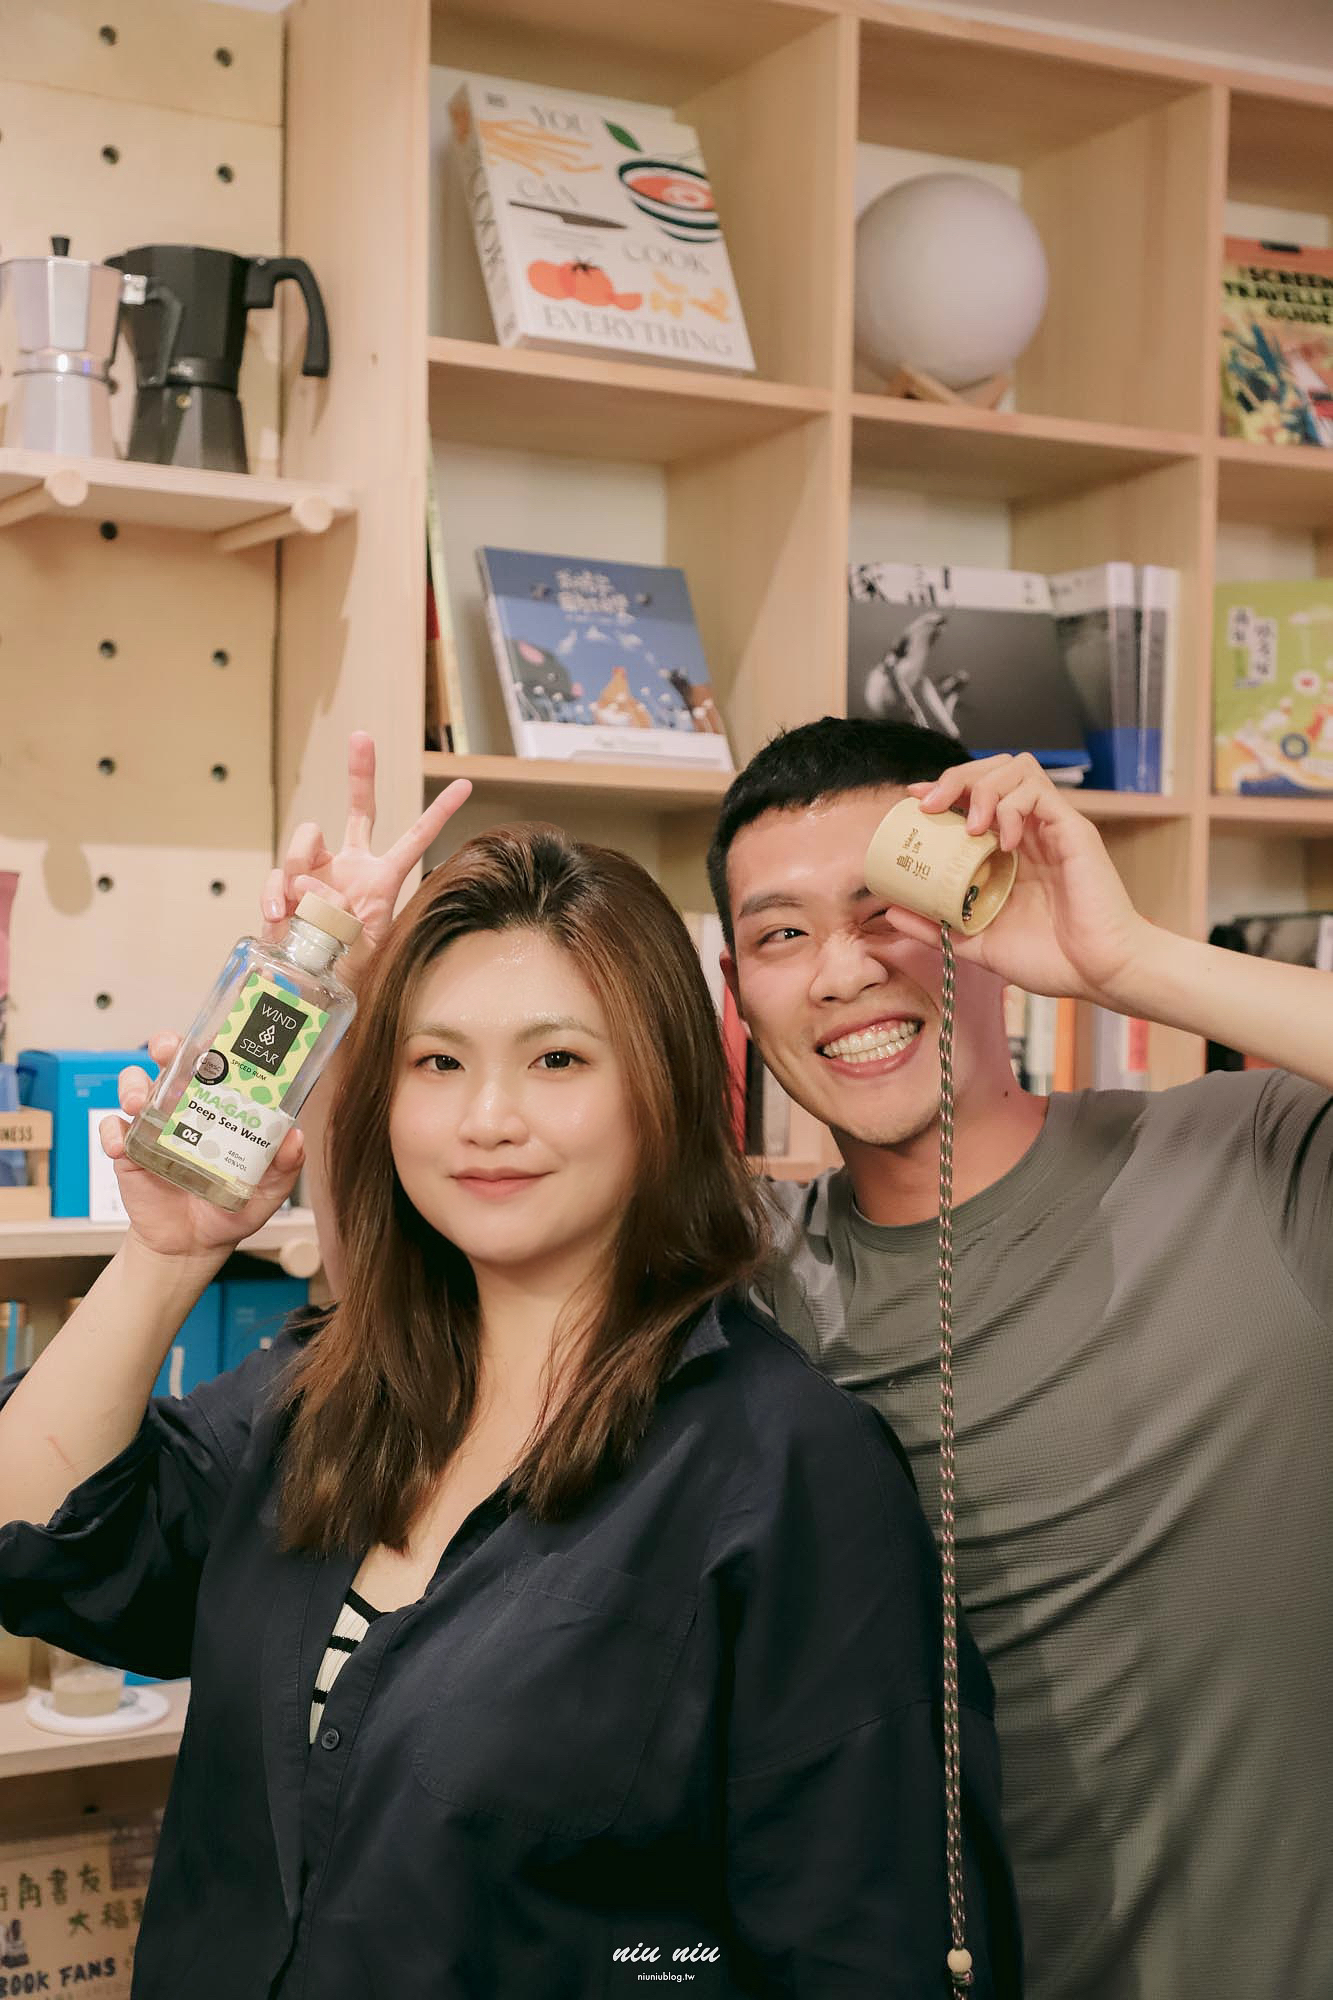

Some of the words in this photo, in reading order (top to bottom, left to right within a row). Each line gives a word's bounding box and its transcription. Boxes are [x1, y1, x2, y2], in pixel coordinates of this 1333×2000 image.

[530, 104, 581, 132] YOU
[516, 178, 580, 206] CAN
[620, 245, 710, 274] COOK
[543, 304, 733, 356] EVERYTHING
[261, 1003, 297, 1030] WIND
[239, 1037, 279, 1066] SPEAR
[231, 1059, 252, 1073] SPICED
[252, 1070, 268, 1081] RUM
[182, 1128, 198, 1144] 06
[188, 1100, 216, 1122] Deep
[218, 1116, 238, 1133] Sea
[240, 1127, 271, 1149] Water
[60, 1957, 116, 1987] FANS
